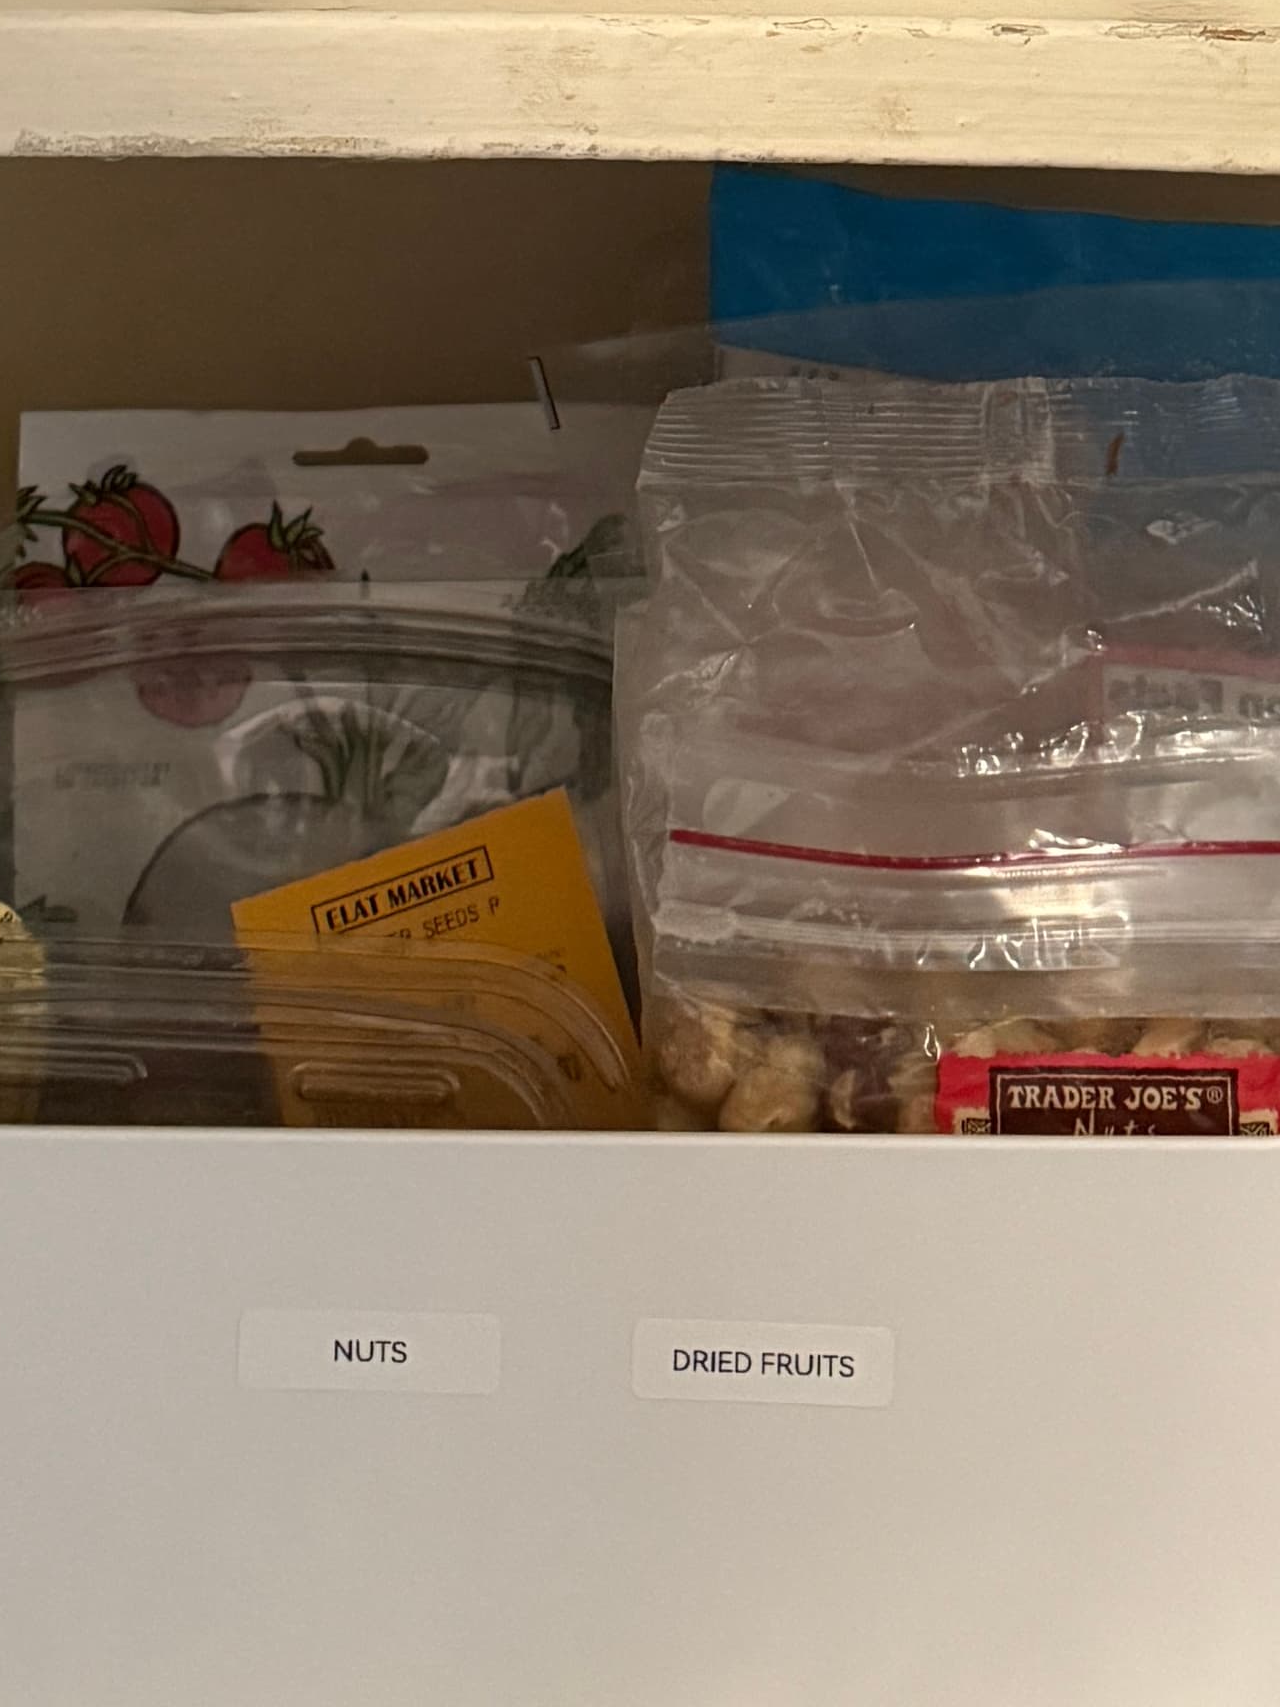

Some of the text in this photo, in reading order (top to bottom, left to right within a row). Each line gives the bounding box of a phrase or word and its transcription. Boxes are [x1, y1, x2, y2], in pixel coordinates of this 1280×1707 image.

[386, 858, 478, 909] MARKET
[422, 903, 481, 938] SEEDS
[1007, 1085, 1116, 1110] TRADER
[332, 1338, 409, 1366] NUTS
[671, 1347, 857, 1379] DRIED FRUITS
